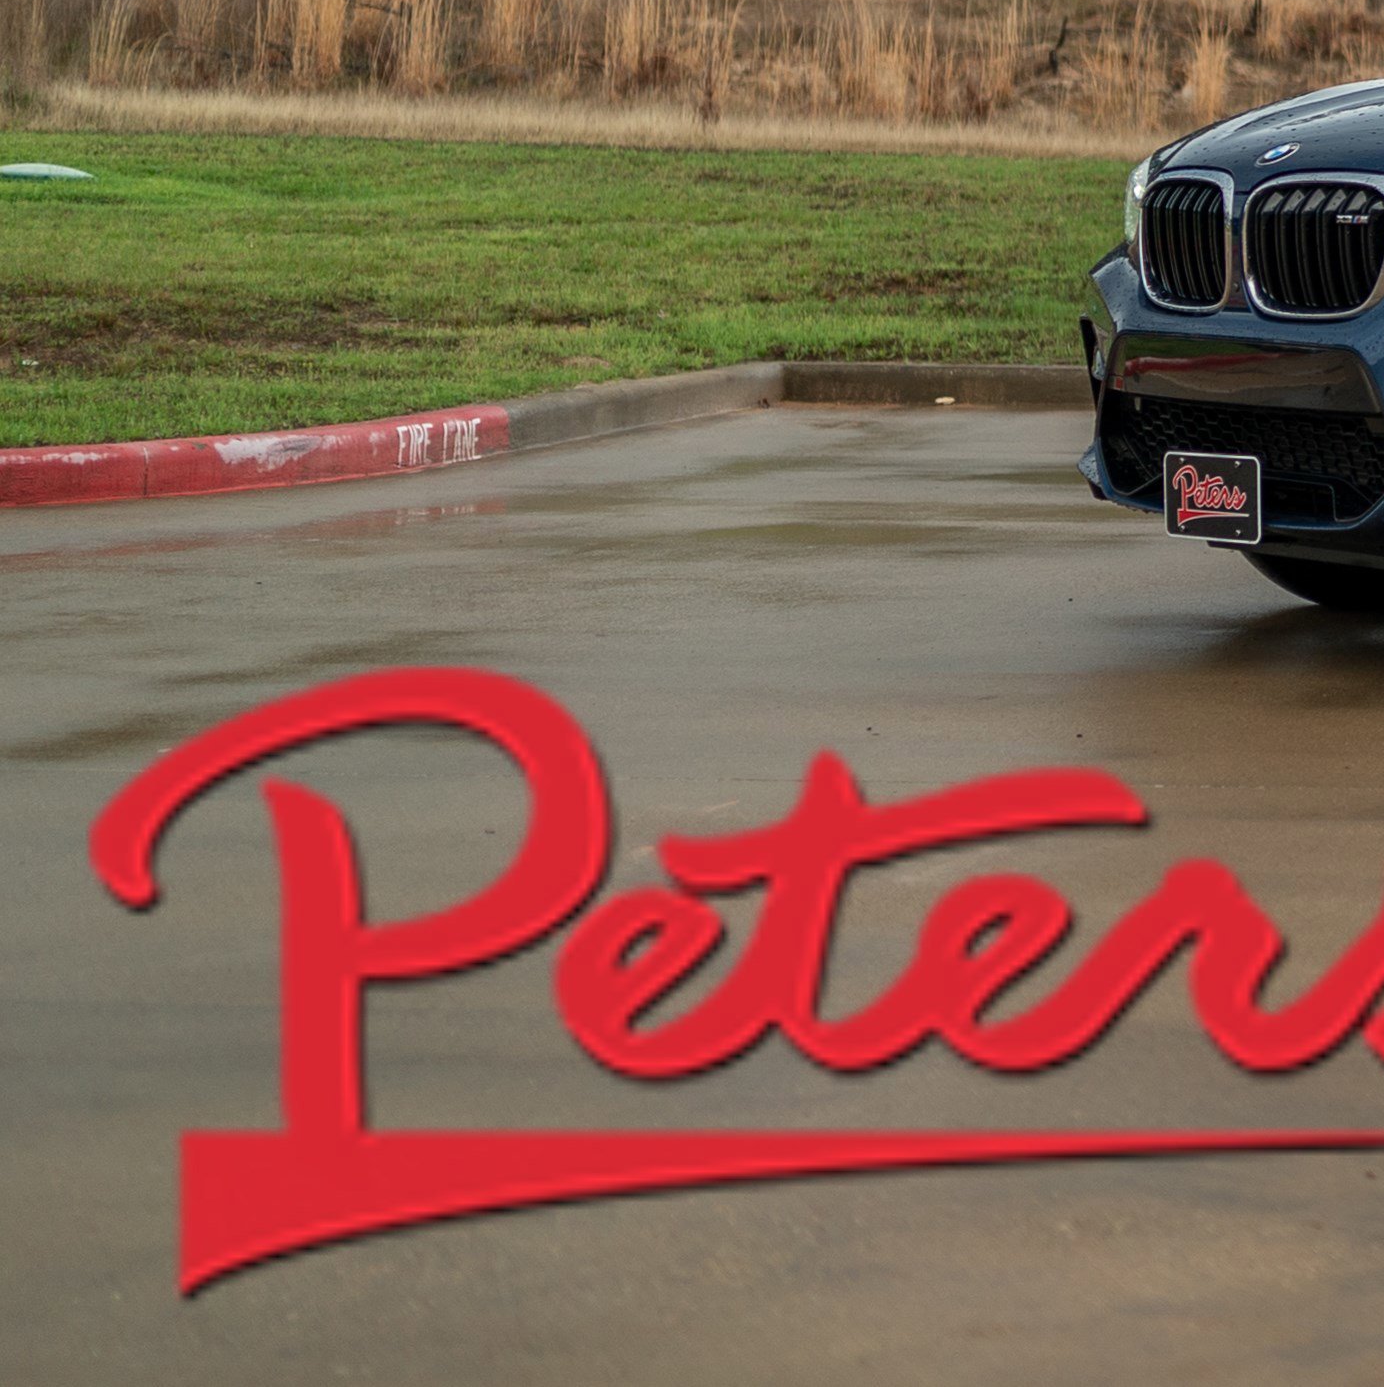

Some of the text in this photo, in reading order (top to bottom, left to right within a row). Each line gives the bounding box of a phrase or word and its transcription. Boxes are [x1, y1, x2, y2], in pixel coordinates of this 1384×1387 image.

[396, 418, 482, 468] FIRE LANE
[1173, 465, 1249, 526] Peters
